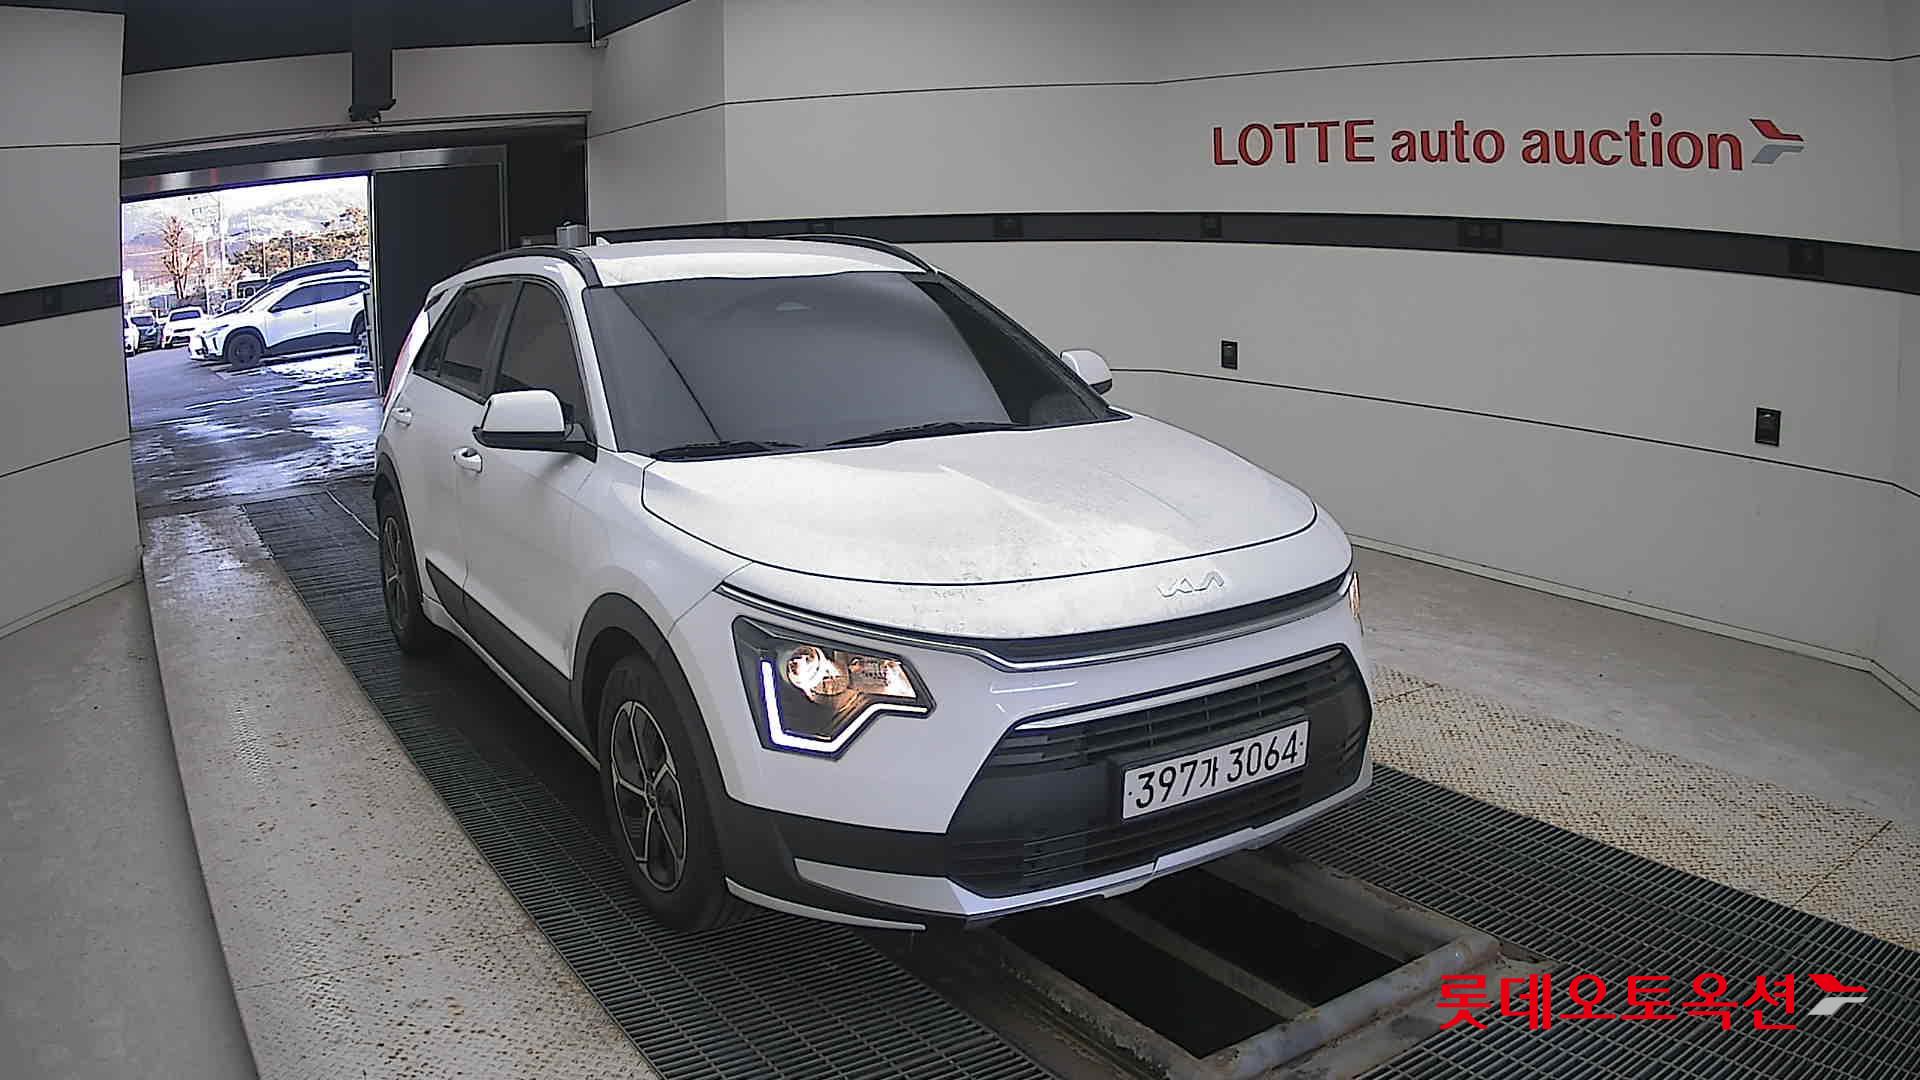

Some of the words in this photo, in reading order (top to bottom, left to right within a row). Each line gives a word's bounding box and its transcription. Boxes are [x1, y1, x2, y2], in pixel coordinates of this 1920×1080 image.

[1213, 119, 1375, 166] LOTTE
[1391, 120, 1505, 164] auto
[1521, 112, 1743, 171] auction
[1135, 756, 1219, 809] 397가
[1226, 729, 1298, 783] 3064
